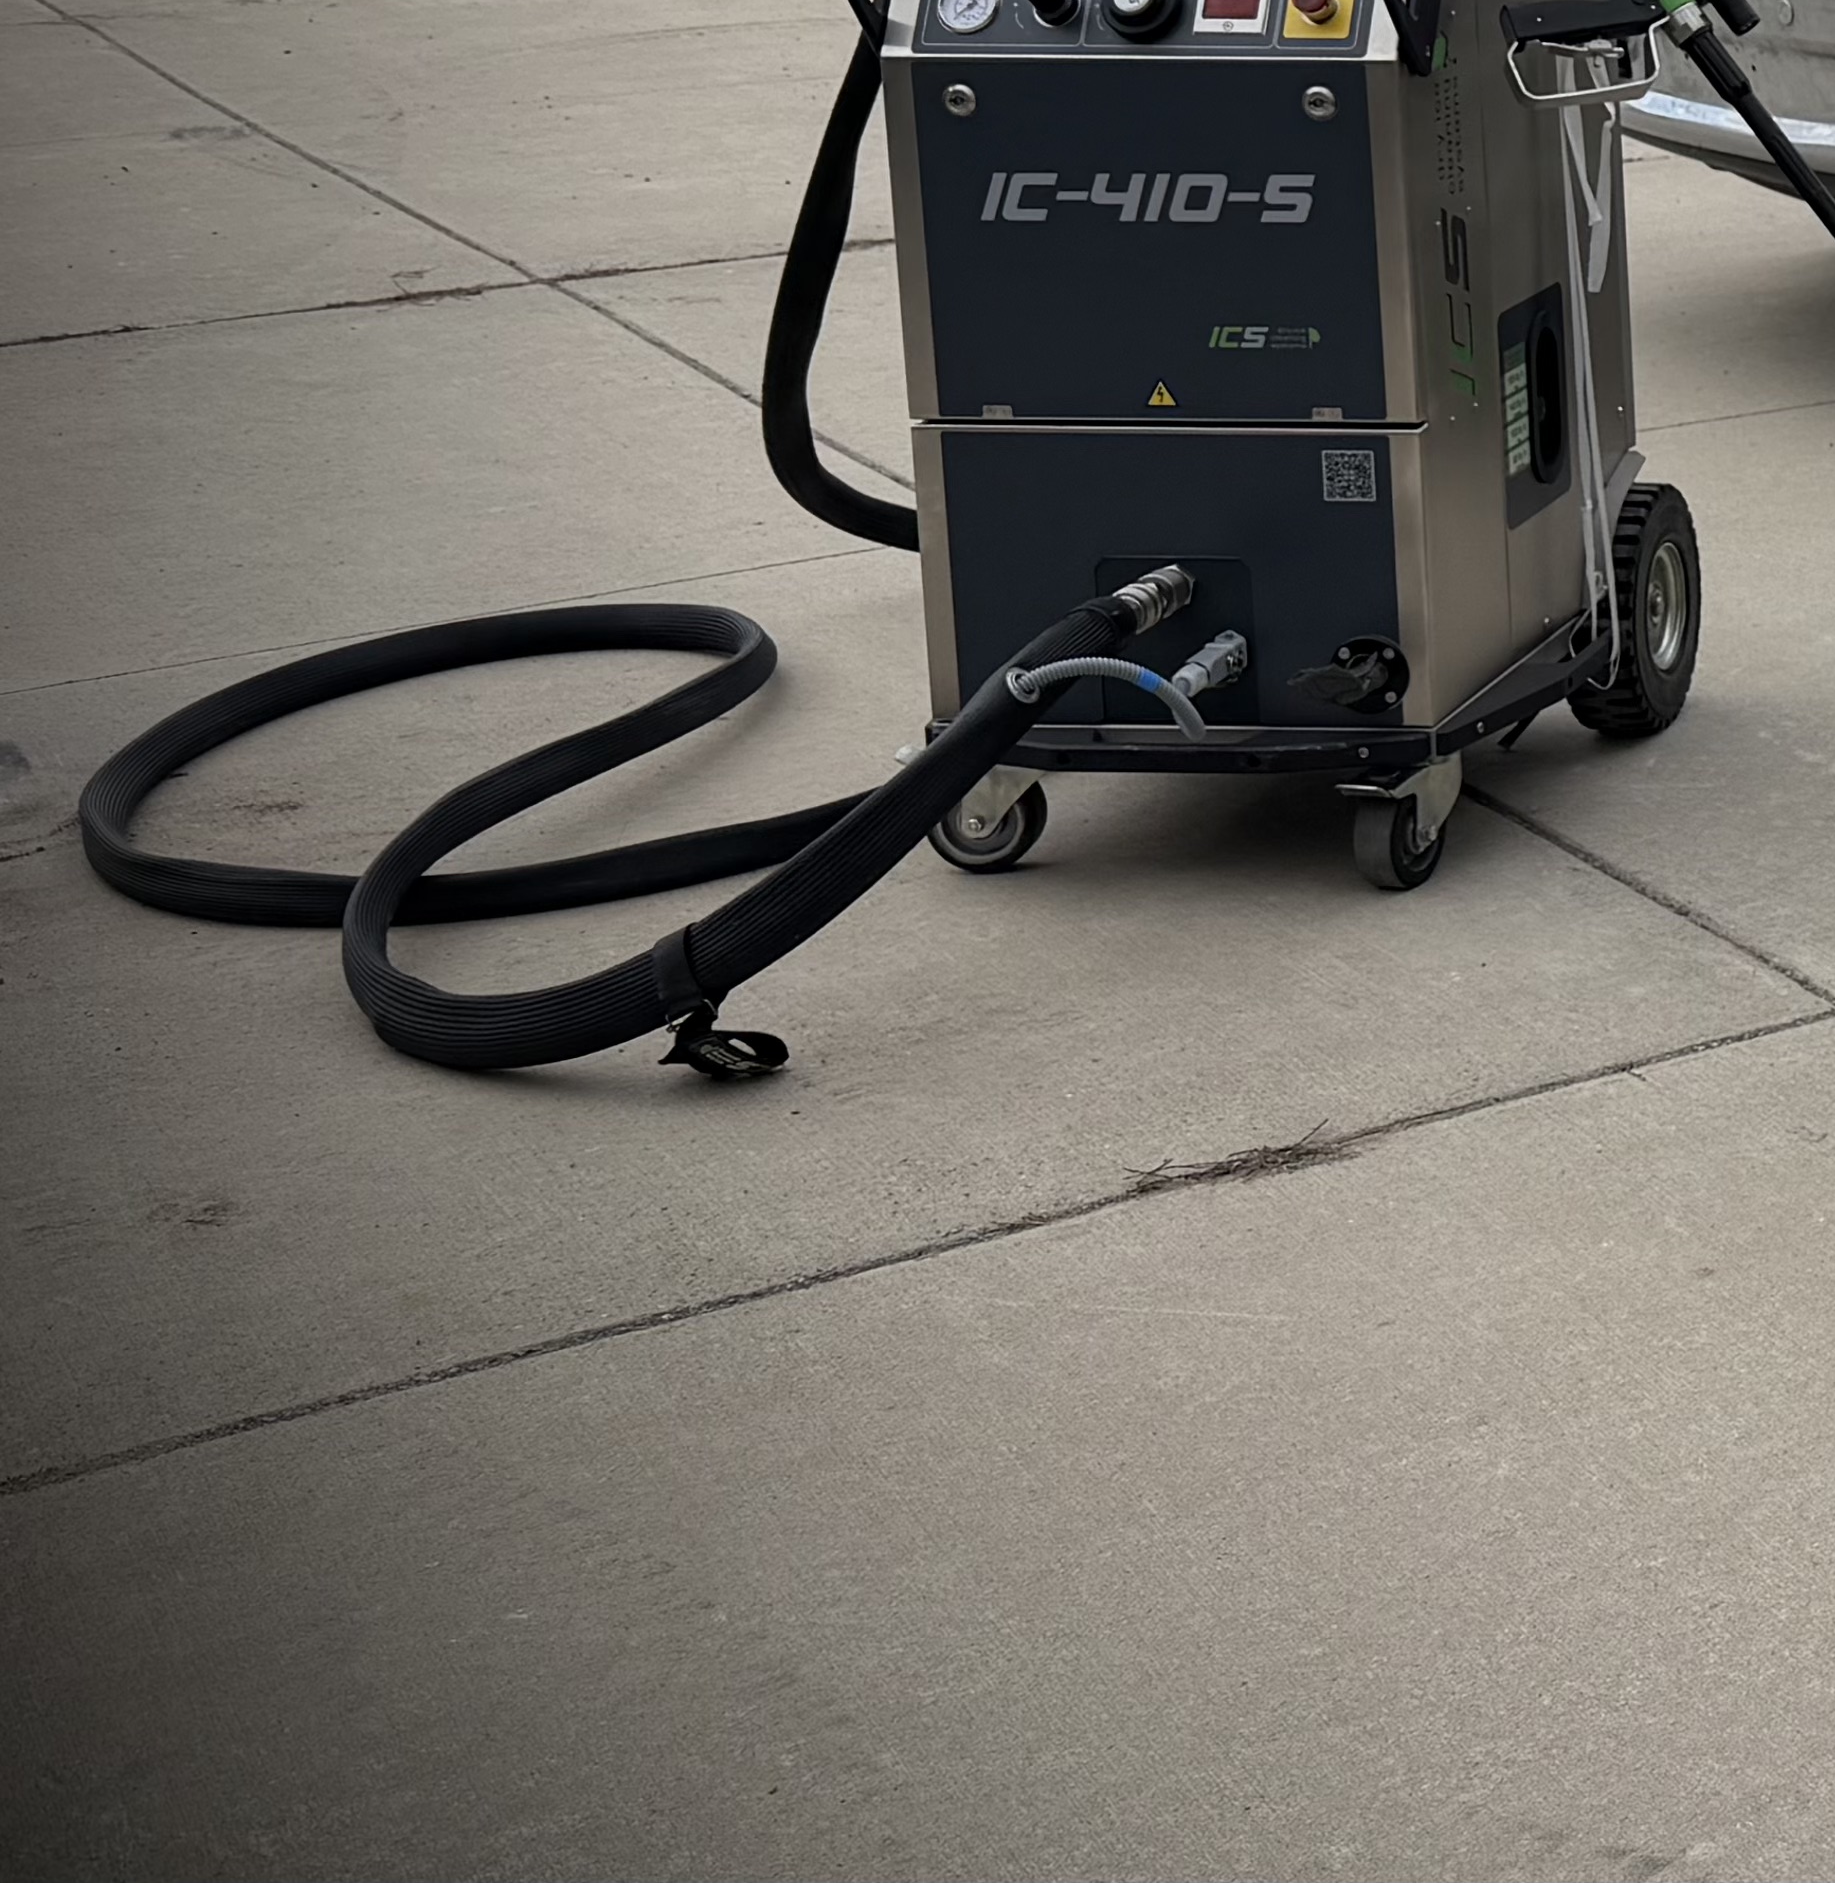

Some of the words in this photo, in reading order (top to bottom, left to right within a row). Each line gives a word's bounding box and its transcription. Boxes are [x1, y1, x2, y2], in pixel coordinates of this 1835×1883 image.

[979, 172, 1317, 224] IC-410-S
[1439, 205, 1478, 397] ICS
[1208, 325, 1270, 349] ICS
